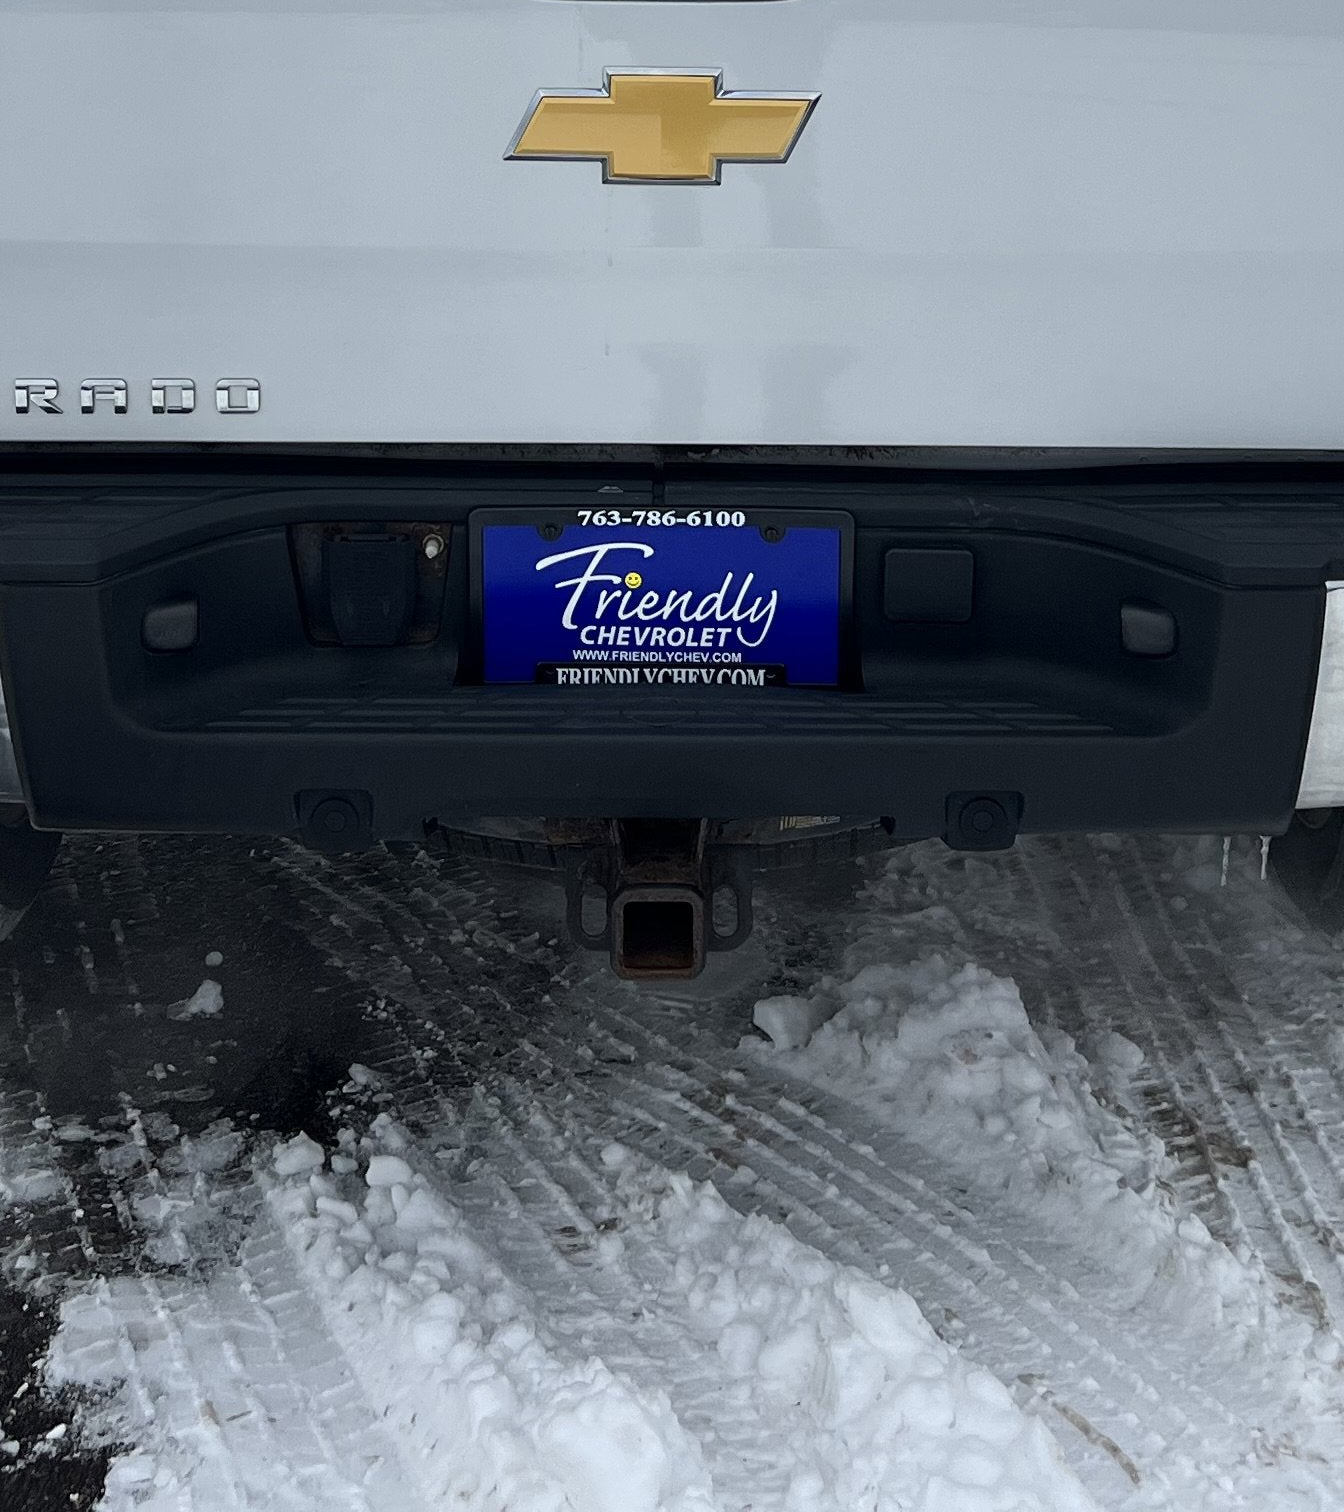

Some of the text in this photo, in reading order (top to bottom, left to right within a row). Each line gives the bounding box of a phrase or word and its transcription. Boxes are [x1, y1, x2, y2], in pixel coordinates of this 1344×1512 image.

[577, 511, 745, 527] 763-786-6100
[536, 542, 777, 647] Friendly
[580, 626, 732, 647] CHEVROLET
[572, 649, 742, 663] WWW.FRIENDLYCHEV.COM
[556, 667, 766, 686] FRIENDLYCHEVCOM
